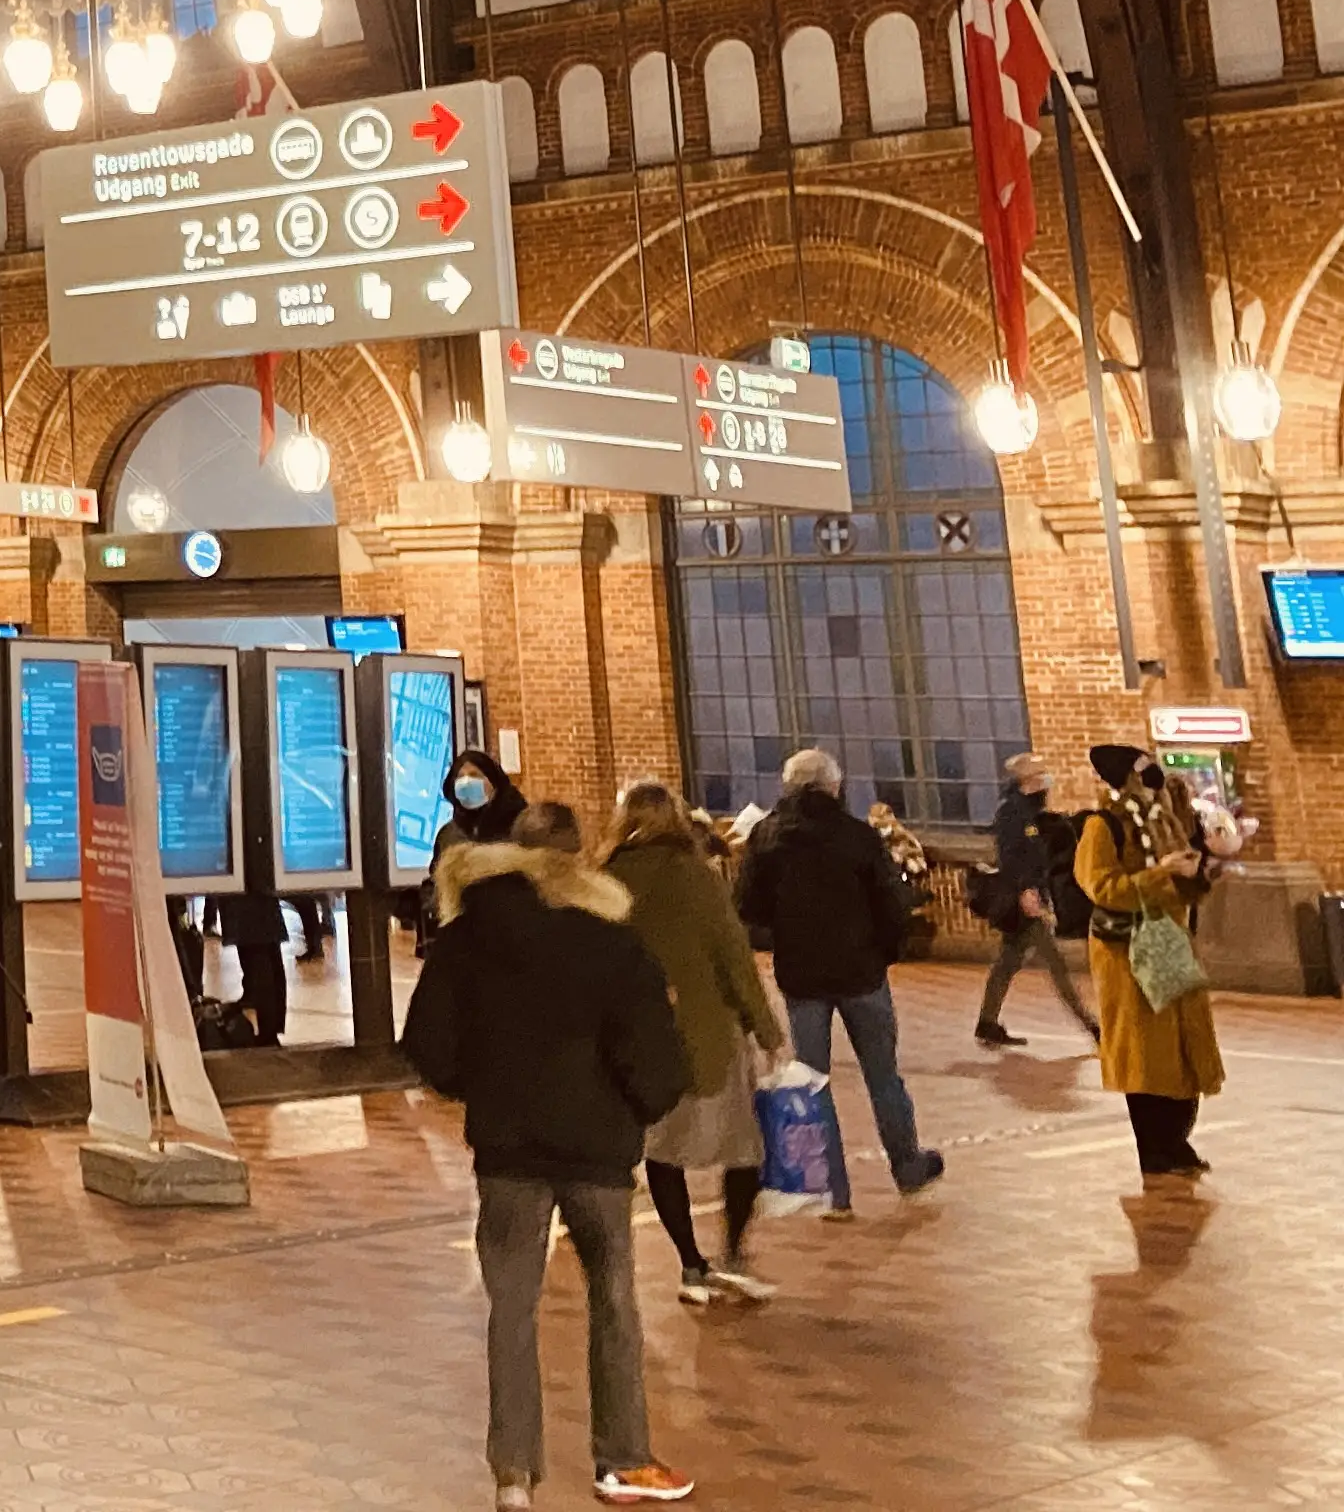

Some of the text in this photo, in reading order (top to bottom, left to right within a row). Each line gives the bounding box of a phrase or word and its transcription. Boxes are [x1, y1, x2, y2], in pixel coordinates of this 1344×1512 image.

[94, 133, 254, 177] Reventlowsgade
[95, 171, 200, 202] Udgang Exit
